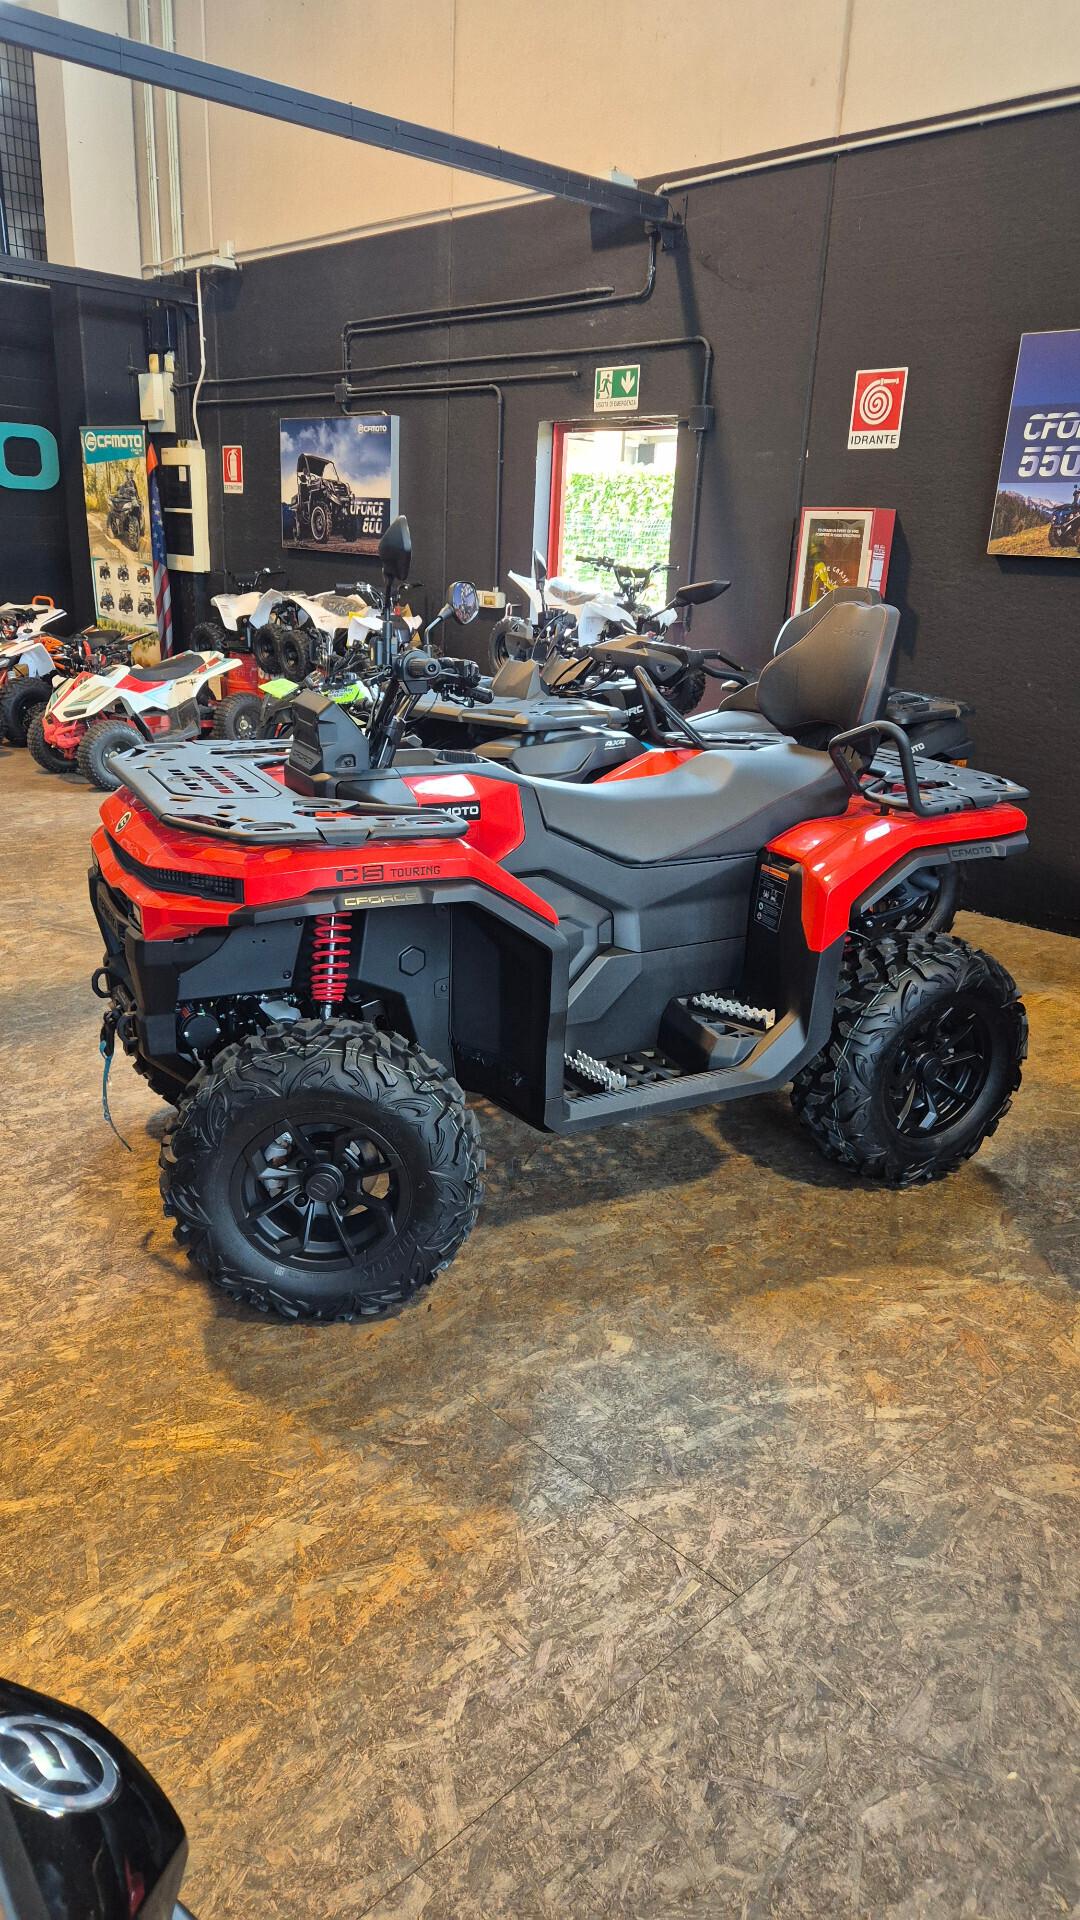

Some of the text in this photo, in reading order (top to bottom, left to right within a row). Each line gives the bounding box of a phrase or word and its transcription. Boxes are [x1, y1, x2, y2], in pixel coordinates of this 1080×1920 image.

[1023, 411, 1080, 440] CFO
[97, 434, 142, 448] CFMOTO
[851, 434, 897, 445] IDRANTE
[1018, 445, 1080, 477] 550
[350, 501, 384, 516] UFORCE
[362, 517, 383, 534] 800
[951, 846, 992, 858] CFMOTO
[390, 865, 441, 878] TOURING
[344, 893, 417, 906] CFORCE
